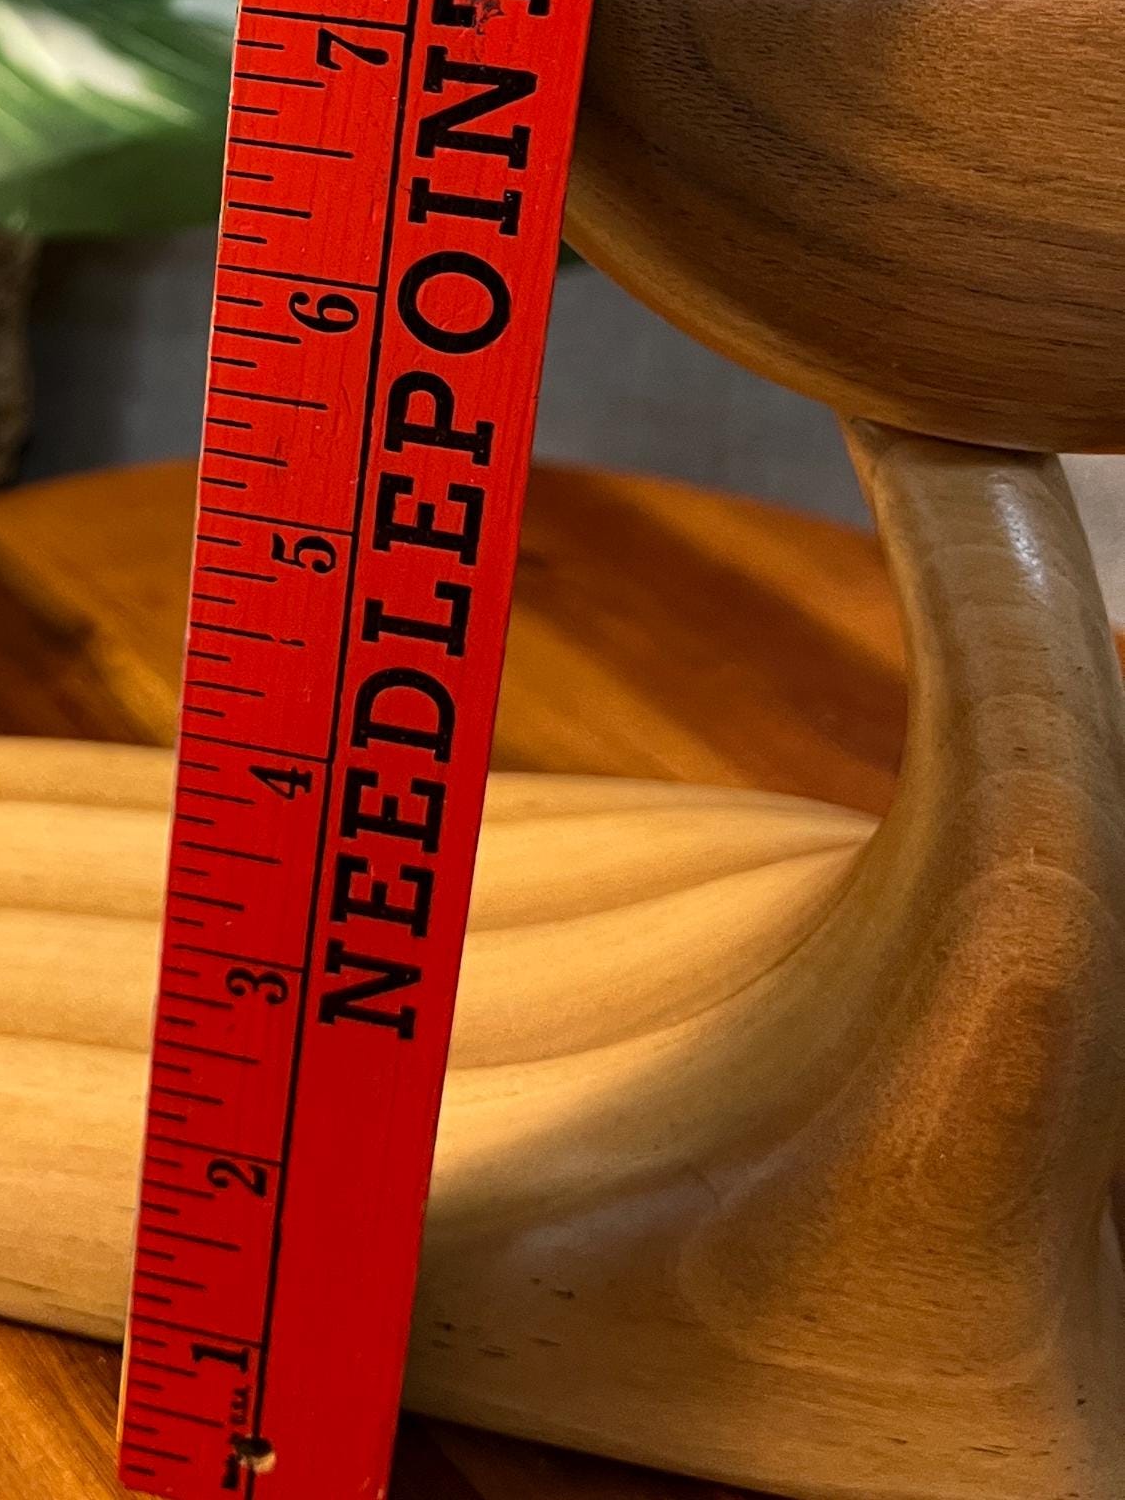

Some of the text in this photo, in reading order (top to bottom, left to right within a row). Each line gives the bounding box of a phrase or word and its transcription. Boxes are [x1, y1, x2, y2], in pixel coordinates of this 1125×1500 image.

[315, 28, 389, 71] 7
[288, 291, 360, 334] 6
[271, 532, 337, 574] 5
[249, 764, 313, 801] 4
[225, 967, 289, 1006] 3
[207, 1158, 268, 1198] 2
[191, 1343, 250, 1374] 1
